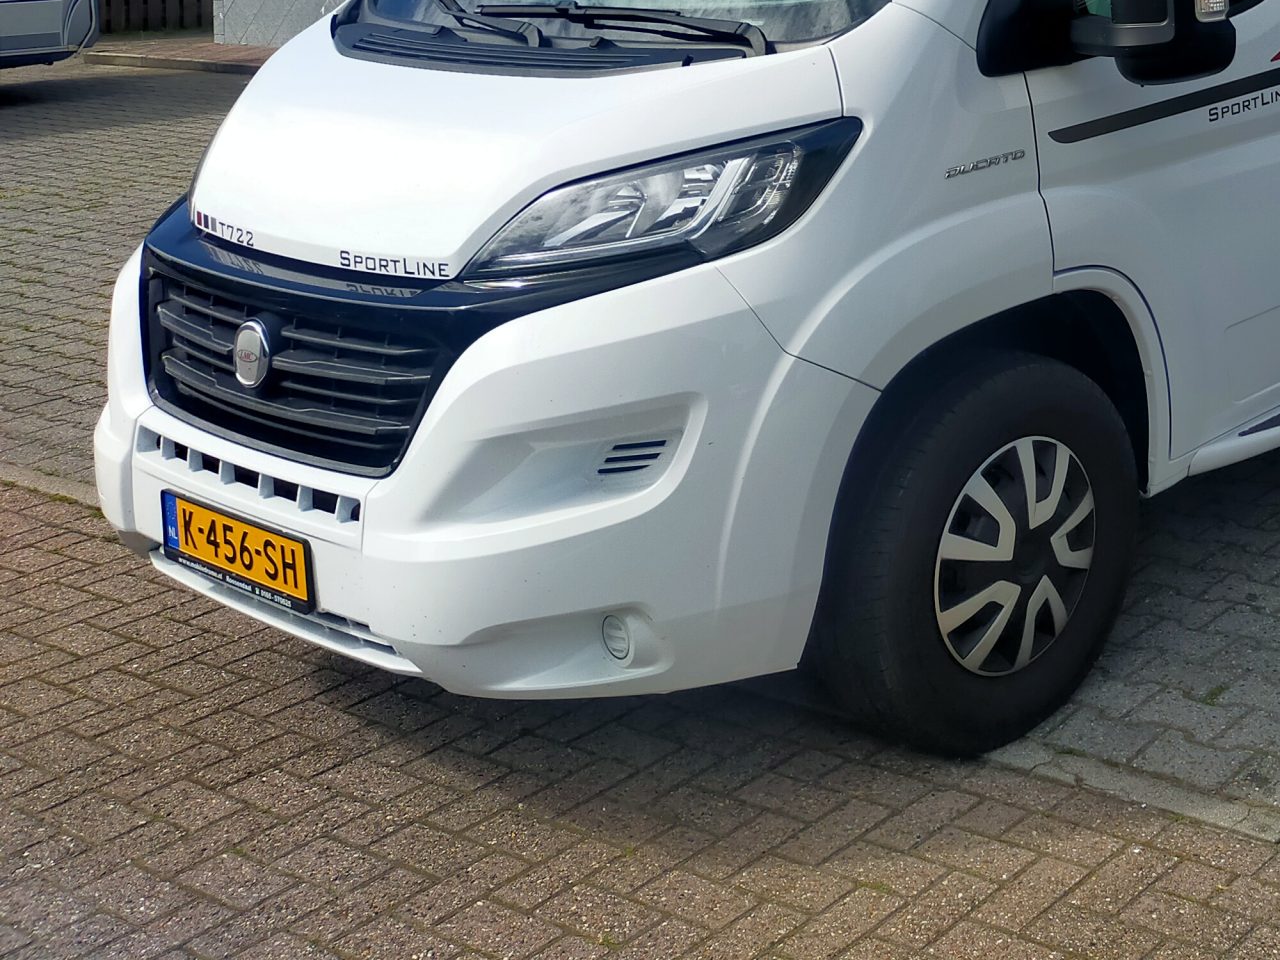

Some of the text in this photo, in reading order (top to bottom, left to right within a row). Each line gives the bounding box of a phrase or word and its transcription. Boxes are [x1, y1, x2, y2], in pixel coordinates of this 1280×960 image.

[945, 149, 1025, 179] DUCATO
[219, 222, 254, 247] T722
[168, 526, 178, 540] NL
[182, 508, 298, 589] K-456-SH
